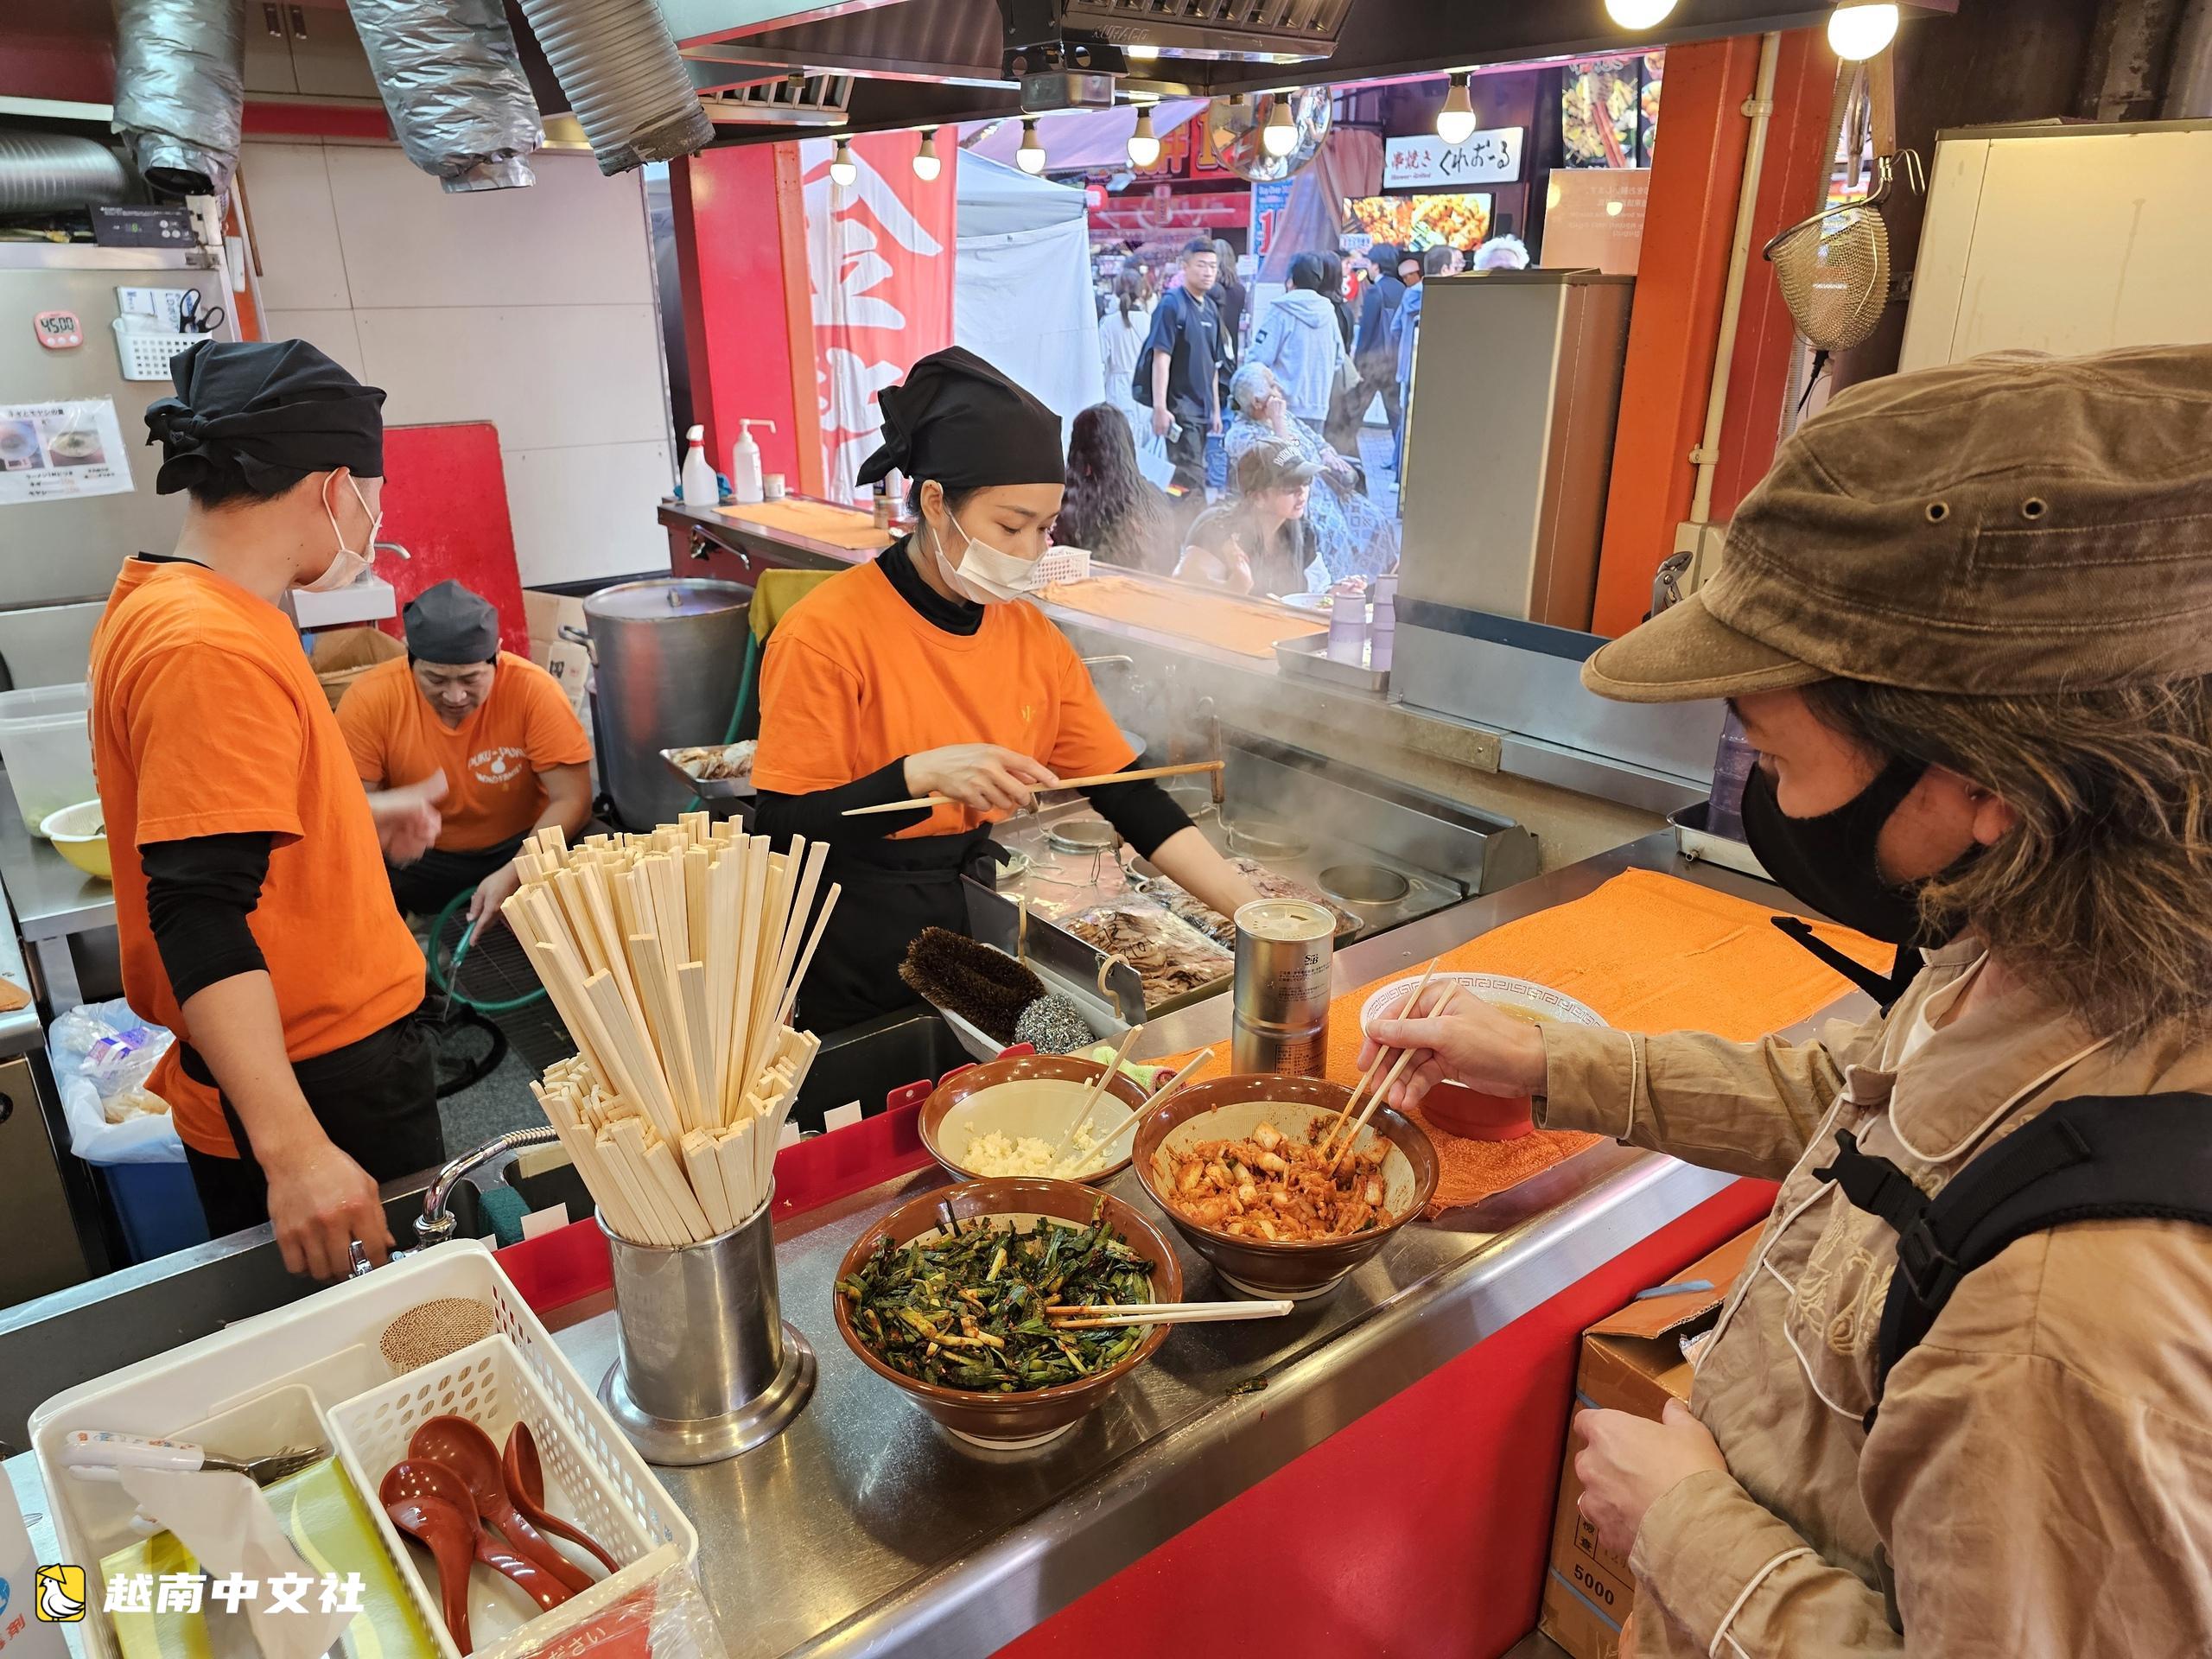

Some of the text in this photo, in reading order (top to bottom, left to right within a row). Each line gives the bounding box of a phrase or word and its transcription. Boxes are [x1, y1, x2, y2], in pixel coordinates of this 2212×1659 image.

[1392, 149, 1432, 170] 串焼き
[1573, 1562, 1615, 1605] 5000
